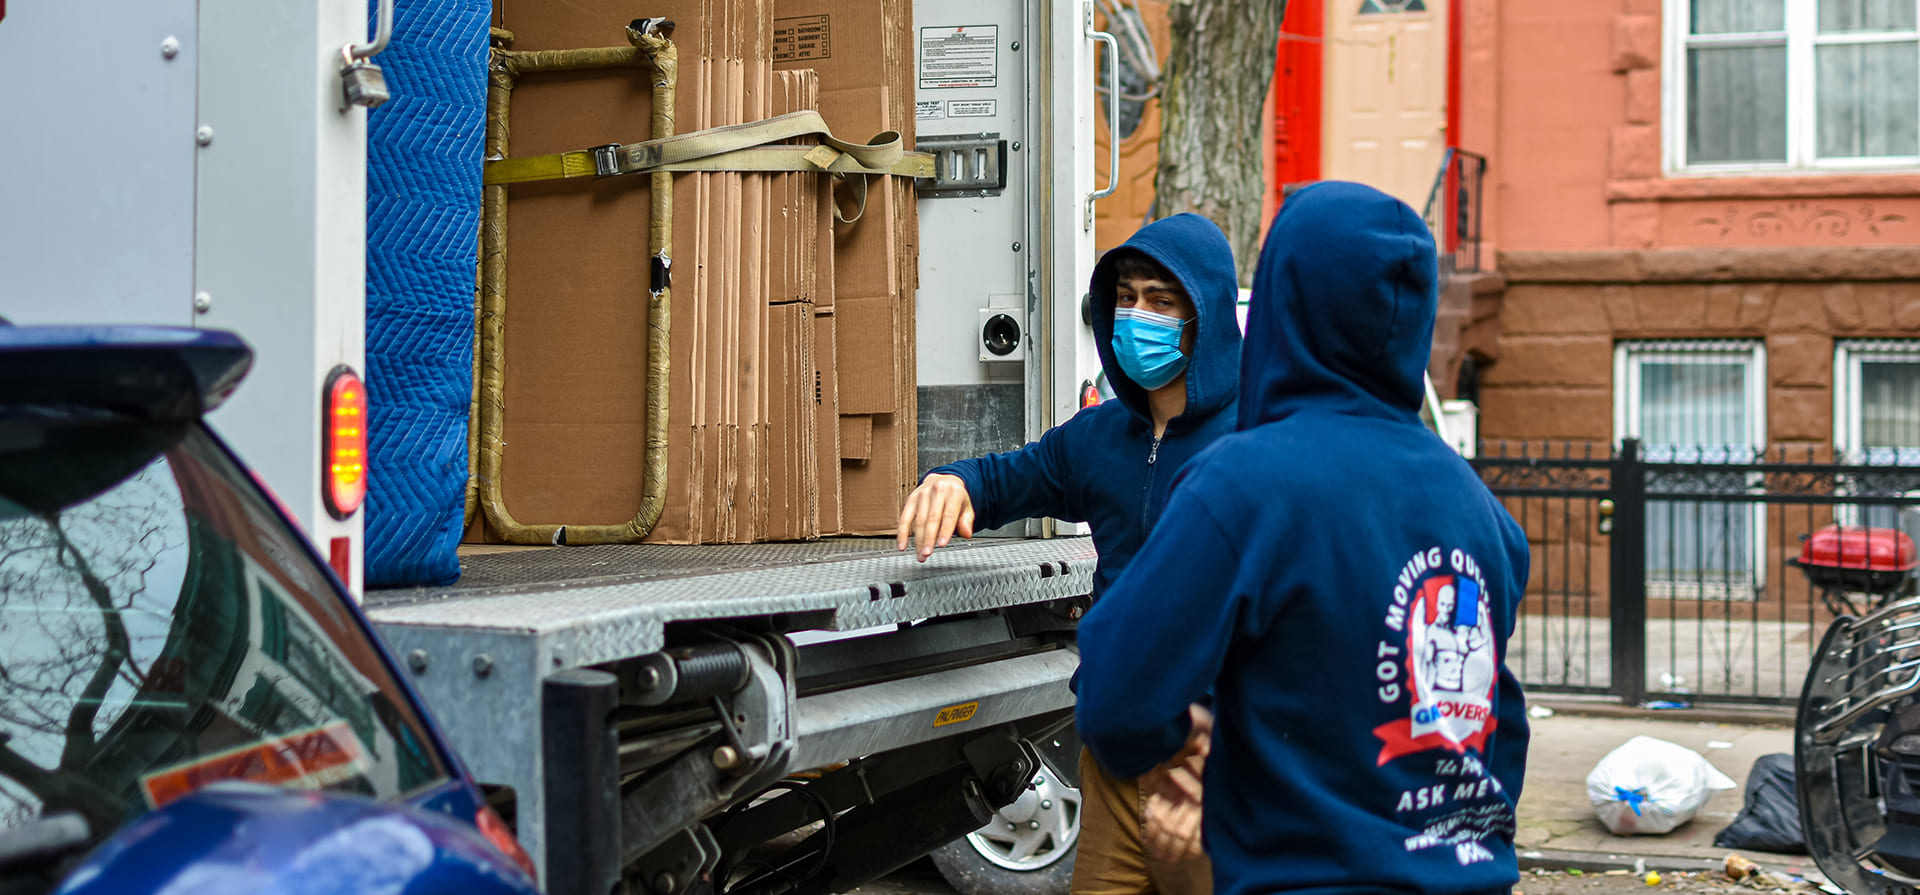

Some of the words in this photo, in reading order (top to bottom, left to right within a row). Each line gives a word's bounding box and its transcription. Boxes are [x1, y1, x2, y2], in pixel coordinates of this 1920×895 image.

[1385, 547, 1442, 633] MOVING
[1376, 641, 1400, 703] GOT
[1396, 784, 1445, 812] ASK
[1453, 779, 1489, 801] ME
